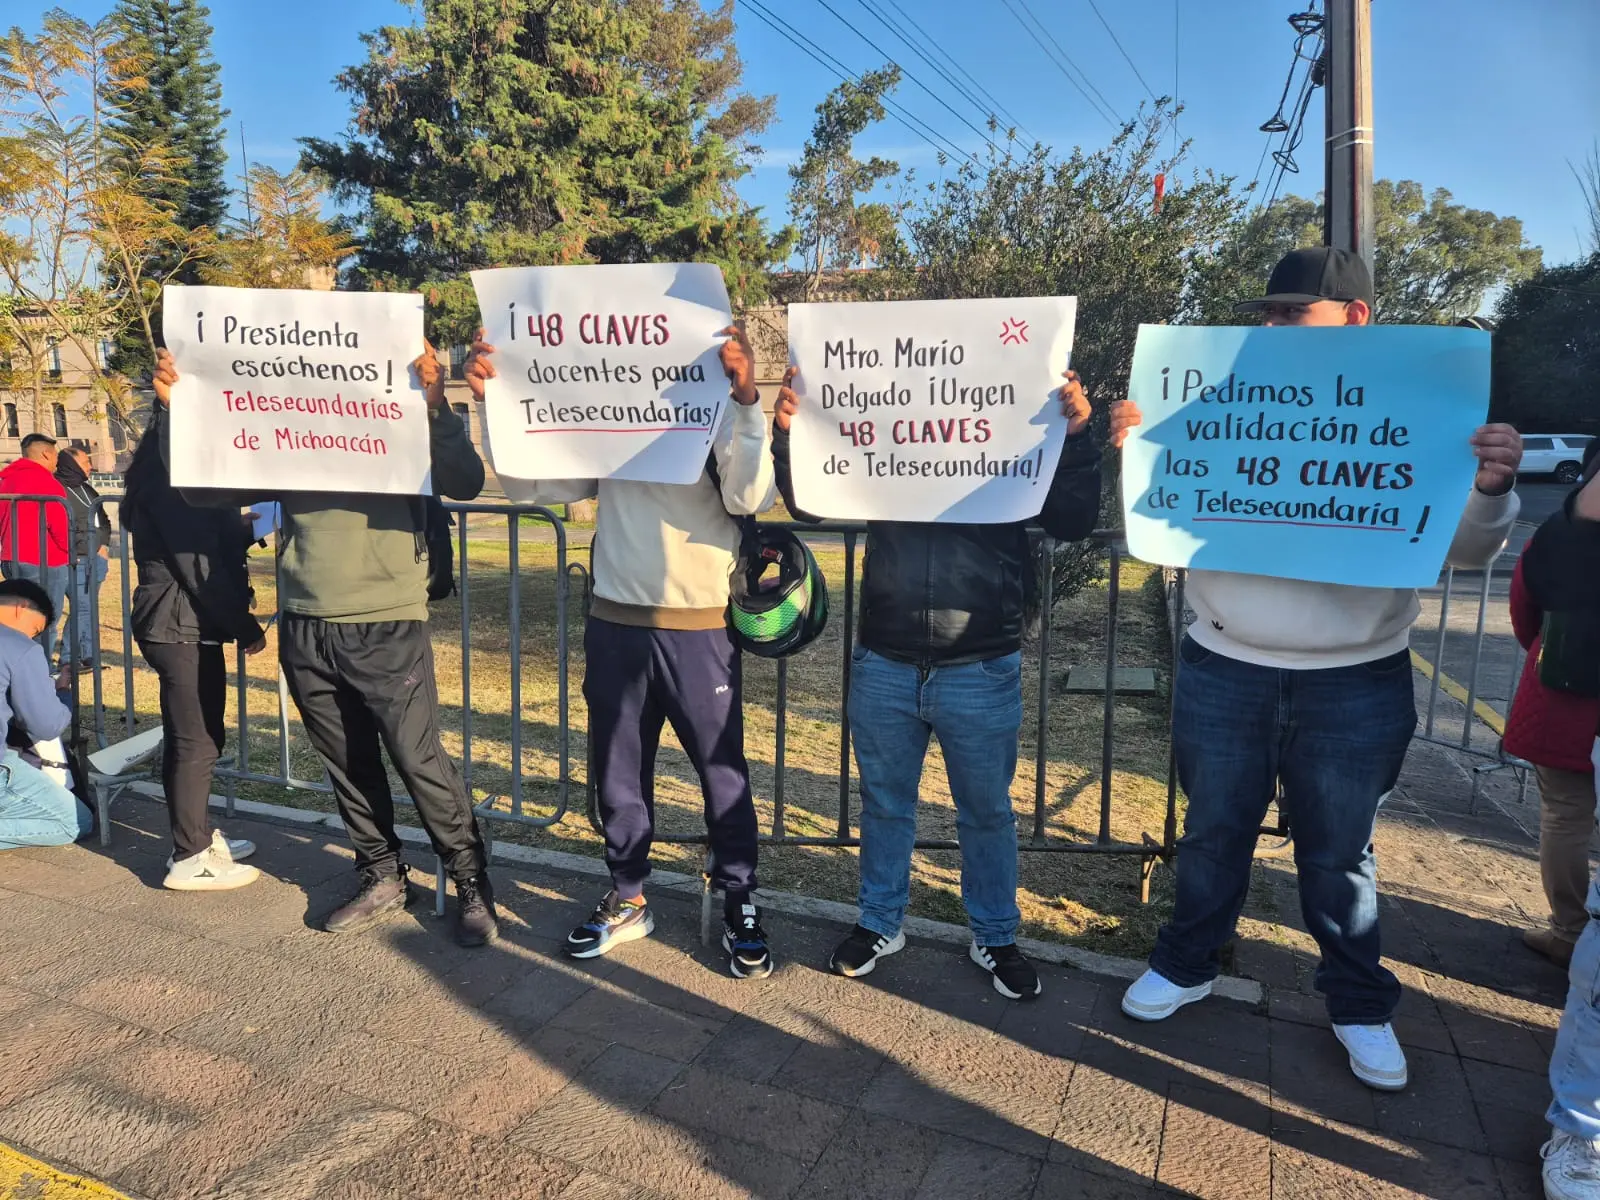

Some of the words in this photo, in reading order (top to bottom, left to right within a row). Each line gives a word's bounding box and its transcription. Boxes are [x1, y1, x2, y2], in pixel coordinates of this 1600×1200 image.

[223, 315, 359, 350] Presidenta
[527, 312, 564, 348] 48
[578, 312, 670, 347] CLAVES
[823, 336, 885, 371] Mtro.
[894, 336, 965, 369] Mario
[231, 354, 393, 395] escúchenos!
[527, 357, 642, 385] docentes
[651, 364, 706, 392] para
[1336, 374, 1364, 408] la
[222, 388, 403, 421] Telesecundarias
[821, 380, 912, 415] Delgado
[519, 397, 720, 446] Telesecundarias!
[838, 420, 876, 448] 48
[891, 417, 992, 445] CLAVES
[1186, 411, 1358, 446] validación
[1369, 417, 1410, 447] de
[232, 427, 261, 451] de
[274, 426, 387, 456] Michoacán
[822, 453, 851, 476] de
[1165, 449, 1209, 478] las
[1236, 456, 1281, 486] 48
[1299, 459, 1413, 491] CLAVES
[1147, 485, 1180, 510] de
